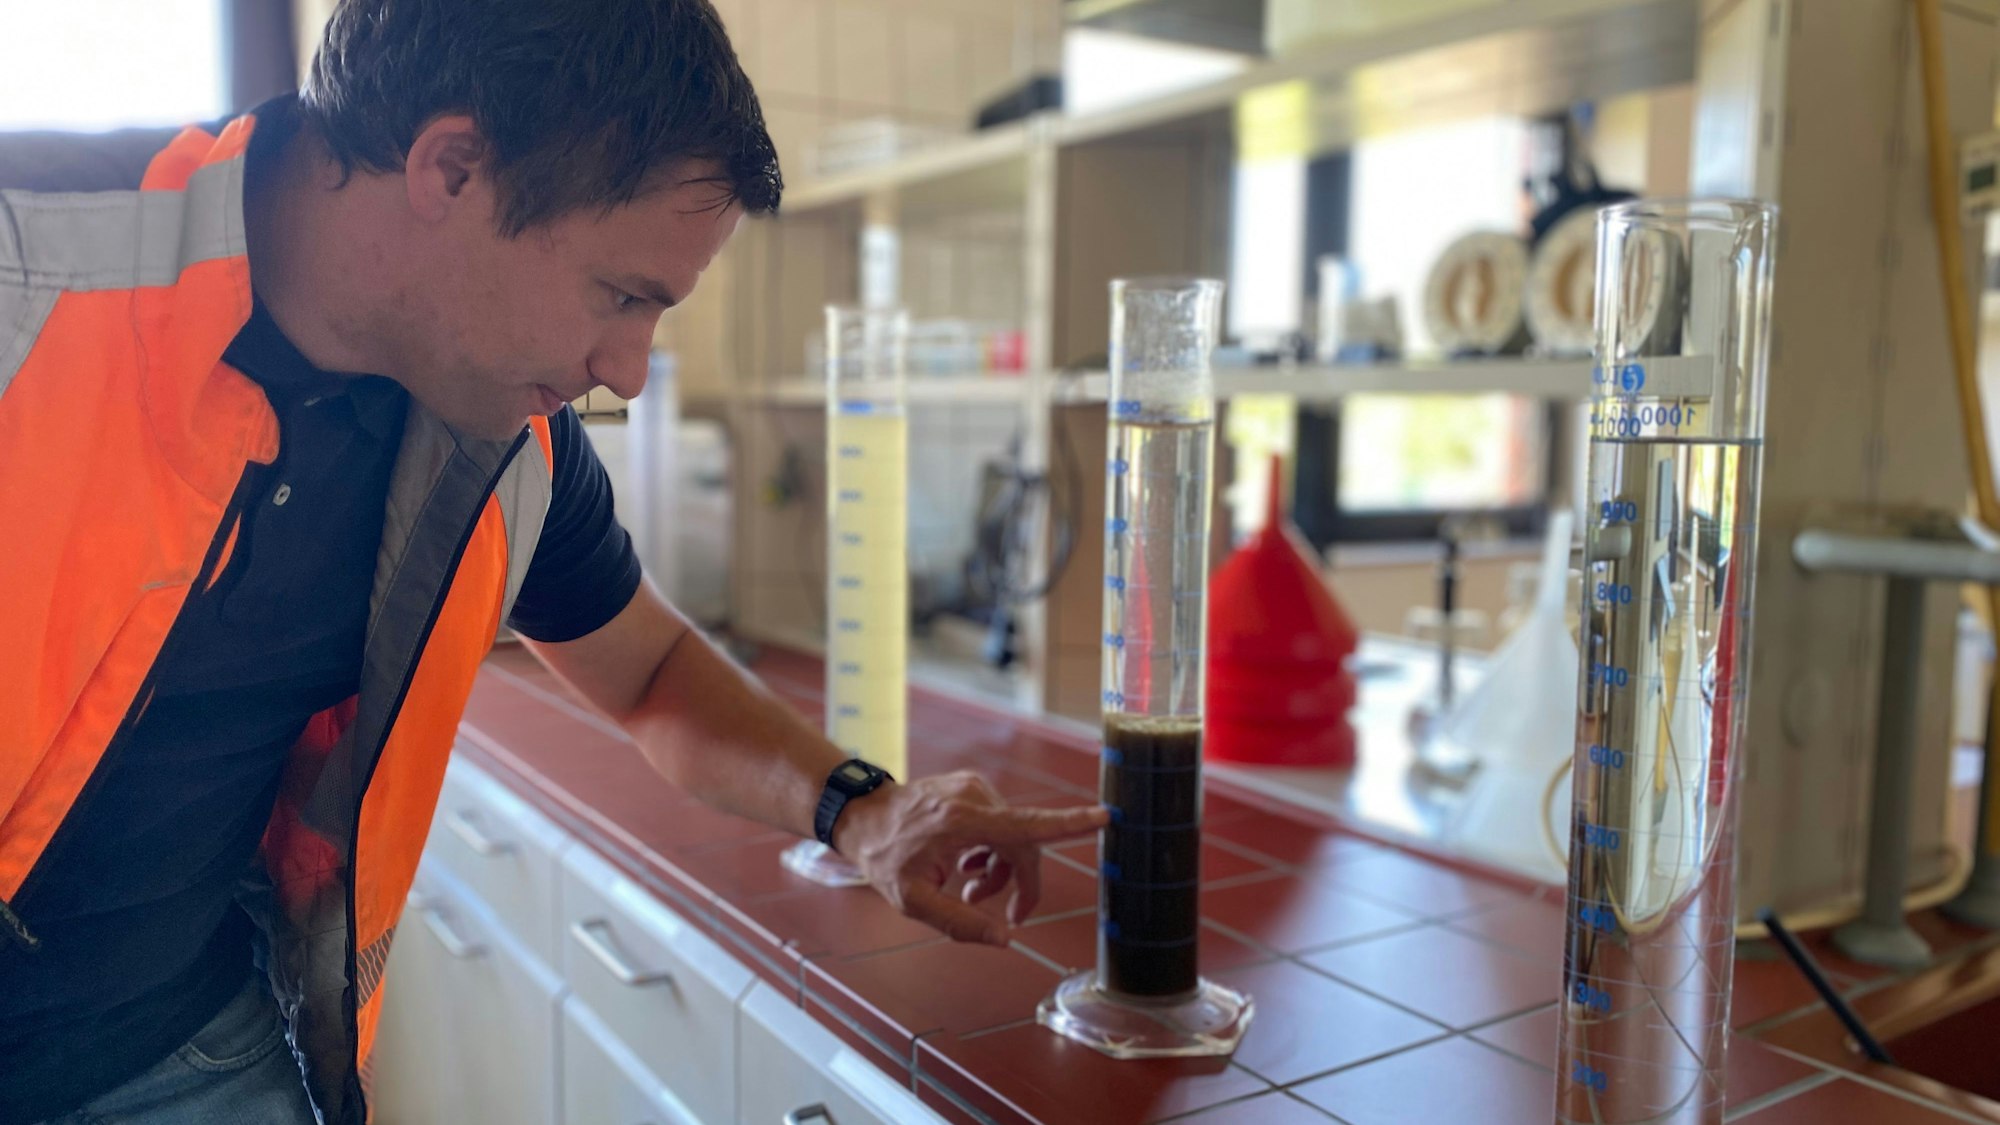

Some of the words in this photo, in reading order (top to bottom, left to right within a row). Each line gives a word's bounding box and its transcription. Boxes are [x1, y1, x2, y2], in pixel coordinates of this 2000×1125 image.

[1598, 582, 1632, 604] 800
[1593, 662, 1628, 687] 700
[1589, 745, 1624, 769] 600
[1584, 824, 1619, 850] 500
[1577, 982, 1612, 1011] 300
